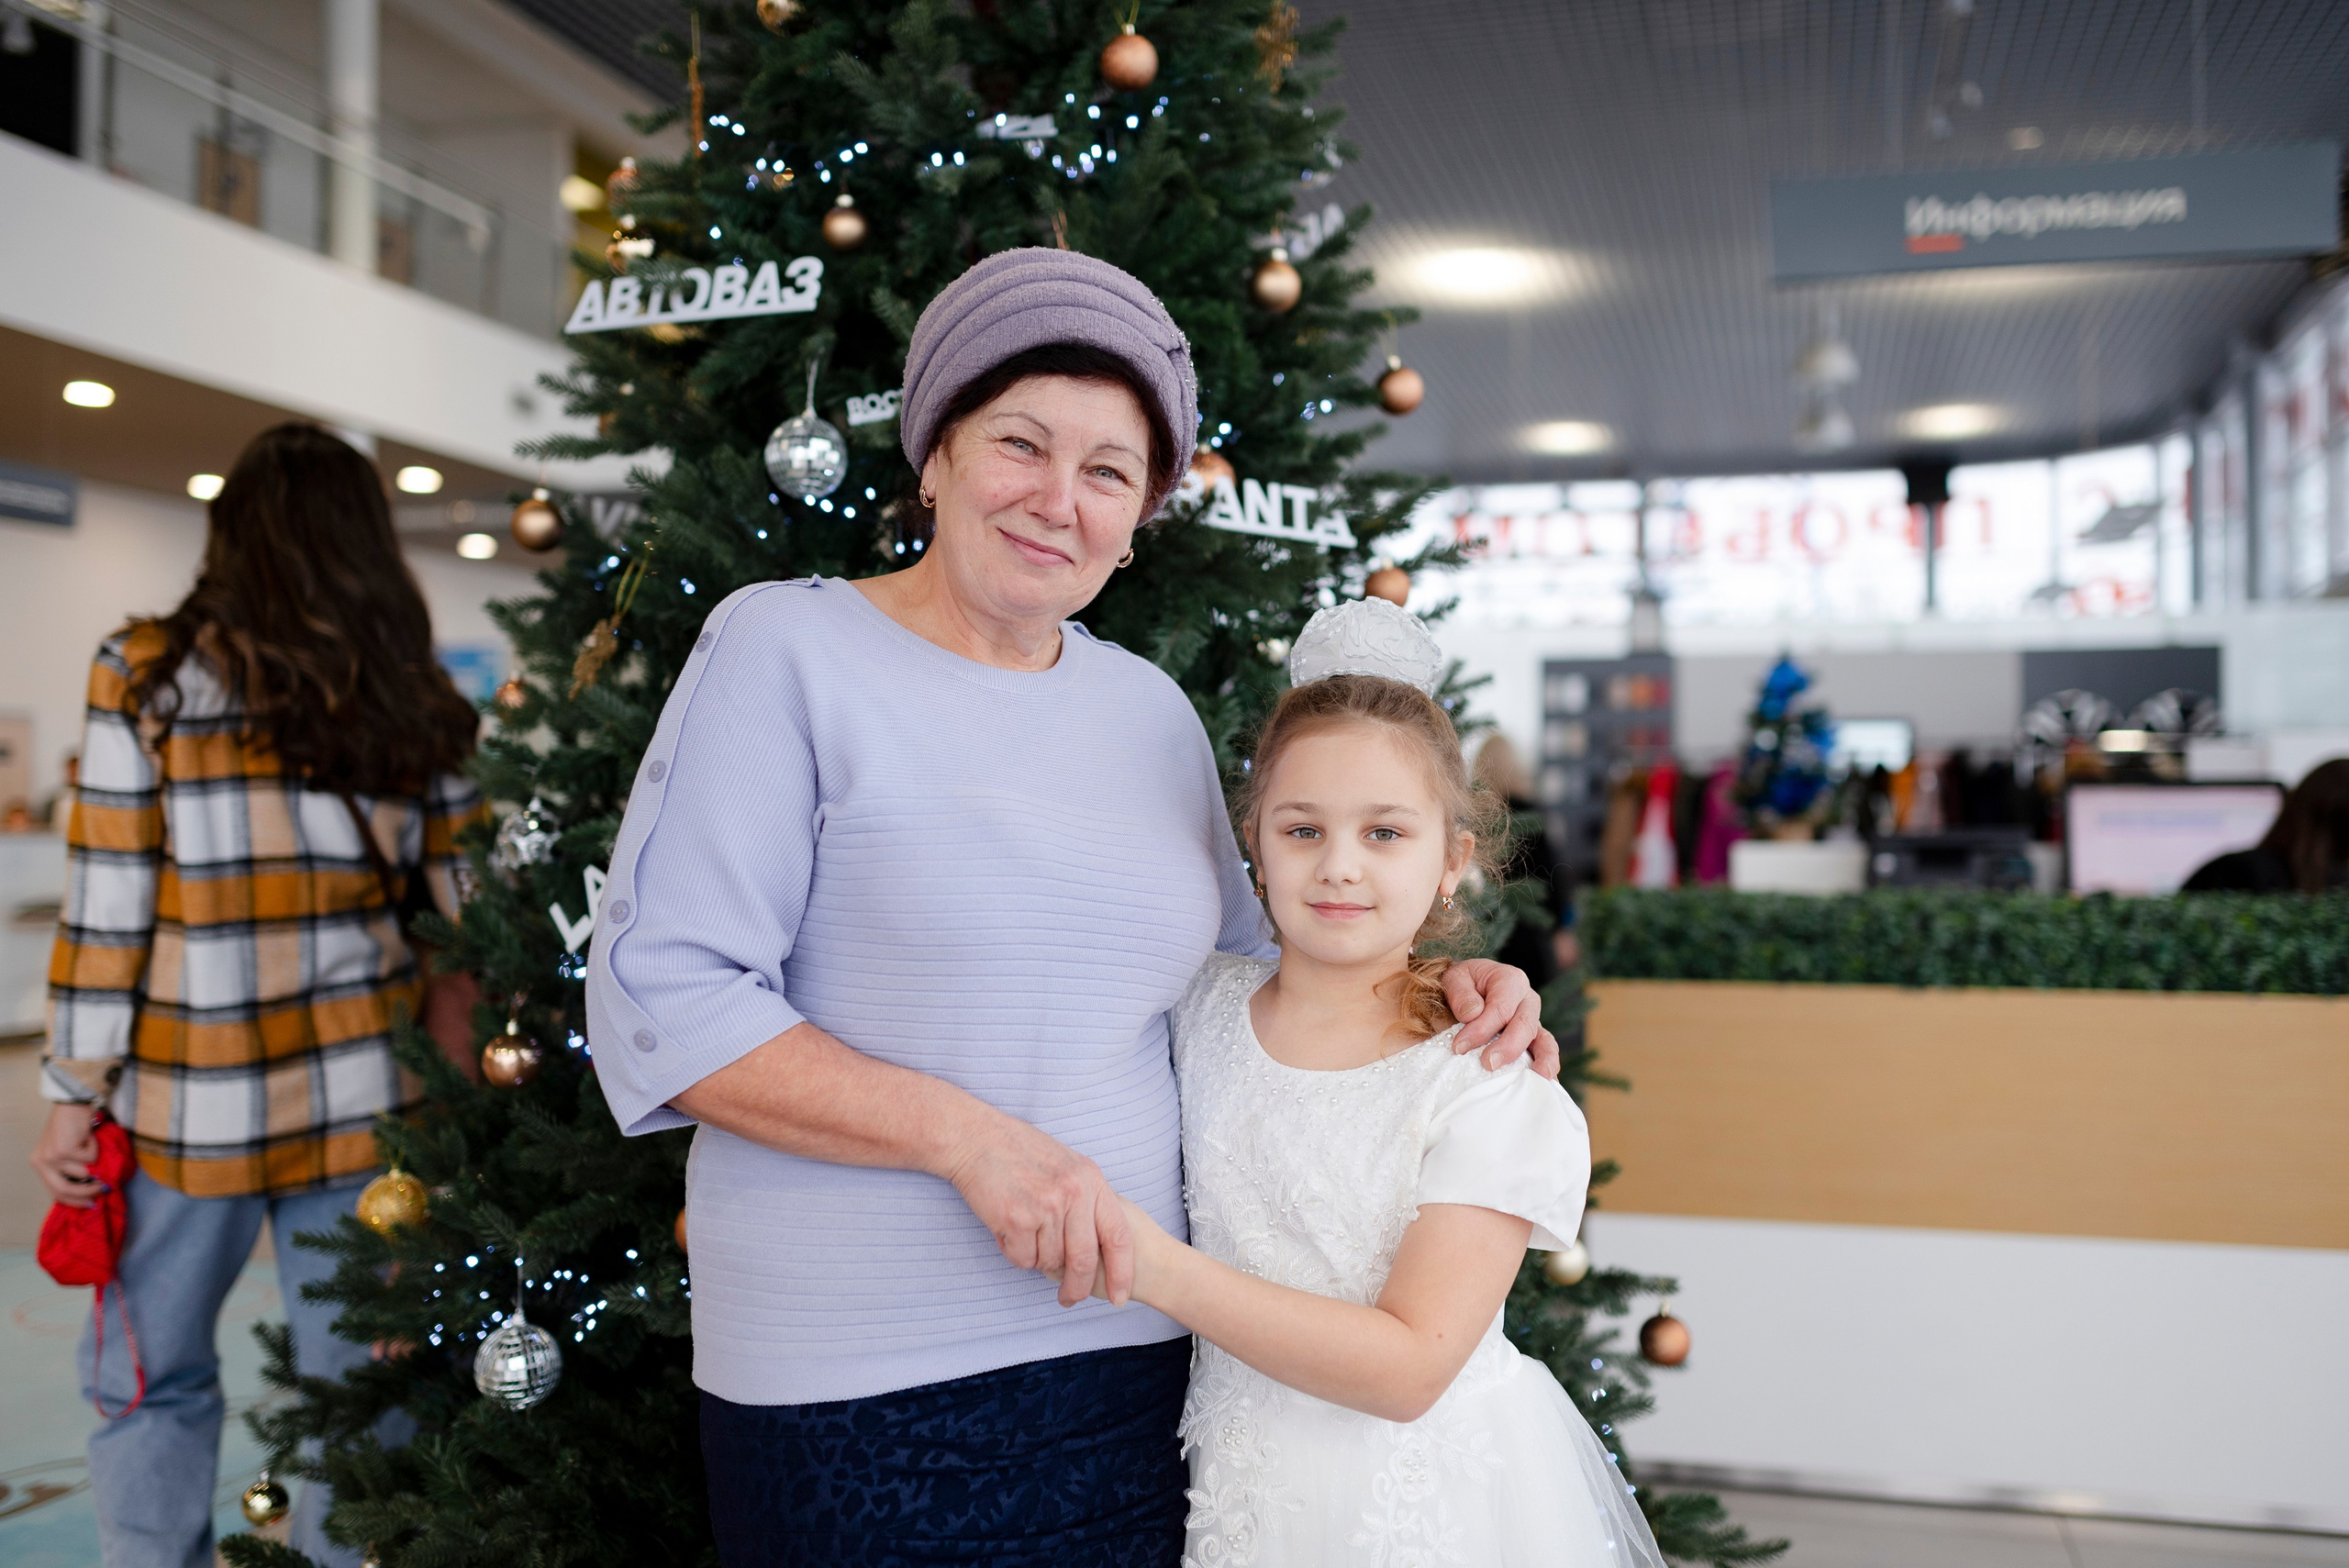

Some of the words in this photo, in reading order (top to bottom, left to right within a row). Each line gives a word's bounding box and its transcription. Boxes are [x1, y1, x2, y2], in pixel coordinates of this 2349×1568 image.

[1903, 188, 2188, 243] Информация
[563, 256, 824, 334] АВТОВАЗ
[846, 387, 904, 426] ВОС
